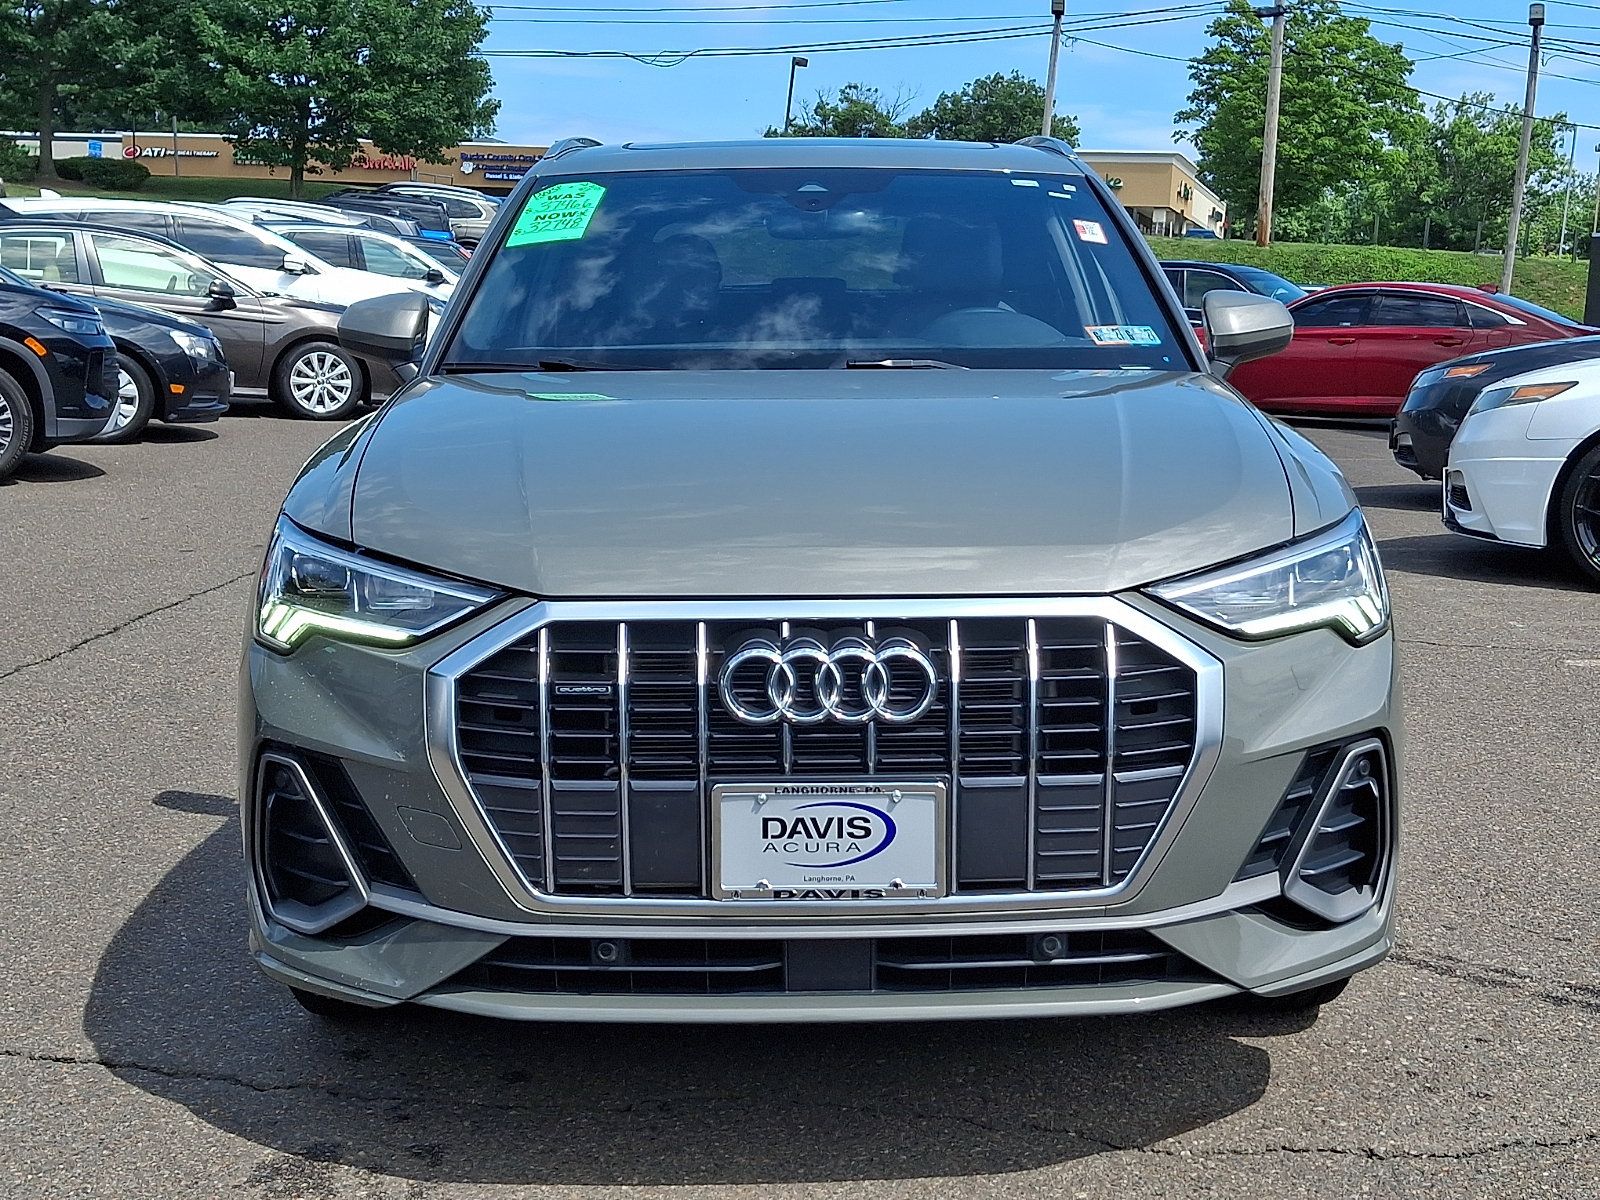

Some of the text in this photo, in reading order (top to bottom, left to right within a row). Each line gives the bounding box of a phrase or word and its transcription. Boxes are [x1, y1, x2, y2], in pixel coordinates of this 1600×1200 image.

[141, 147, 166, 157] ATI
[487, 153, 516, 162] County
[547, 192, 586, 200] WAS
[533, 211, 577, 221] NOW
[762, 816, 872, 839] DAVIS
[763, 842, 862, 853] ACURA
[773, 889, 885, 899] DAVIS
